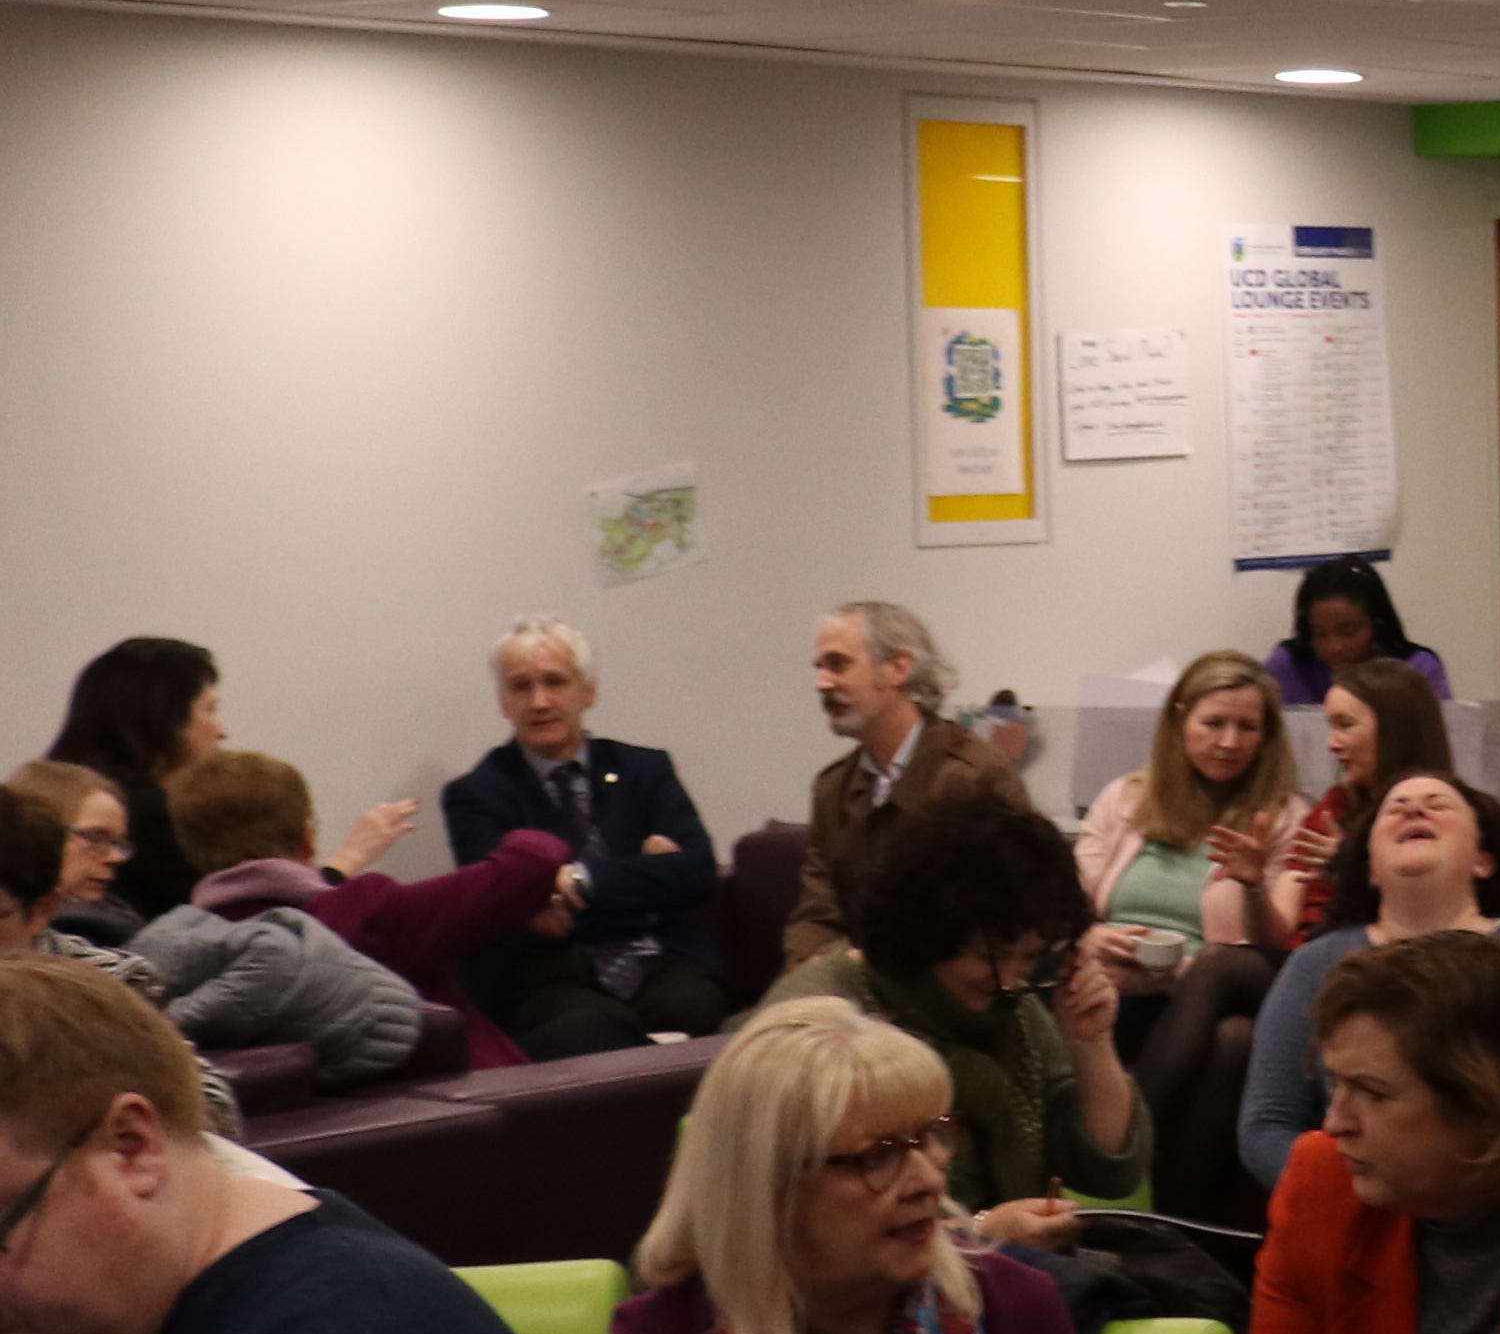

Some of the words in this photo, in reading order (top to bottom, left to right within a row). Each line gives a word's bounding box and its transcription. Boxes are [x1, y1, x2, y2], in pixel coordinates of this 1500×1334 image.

[1231, 269, 1266, 288] UCD
[1272, 269, 1342, 288] GLOBAL
[1231, 291, 1305, 310] LOUNGE
[1309, 291, 1371, 310] EVENTS
